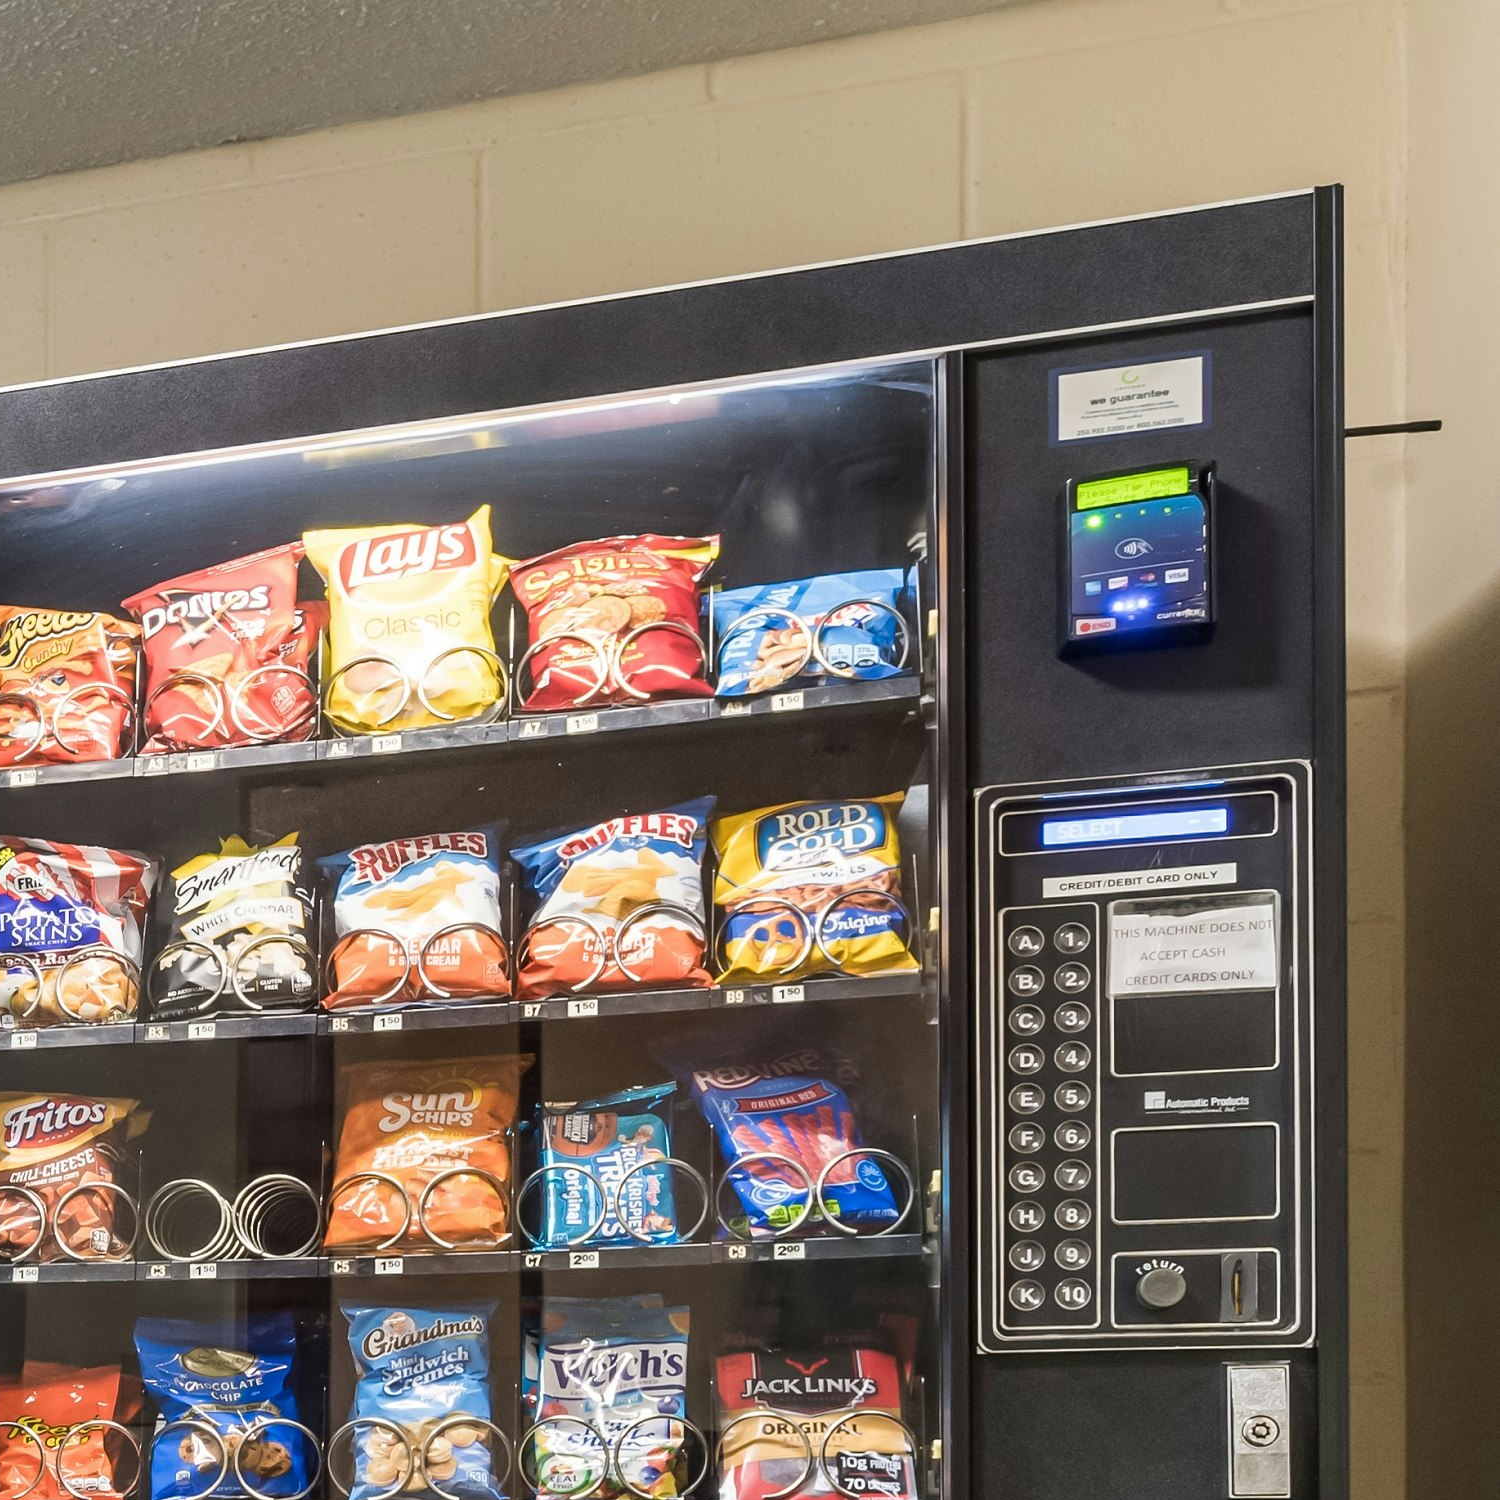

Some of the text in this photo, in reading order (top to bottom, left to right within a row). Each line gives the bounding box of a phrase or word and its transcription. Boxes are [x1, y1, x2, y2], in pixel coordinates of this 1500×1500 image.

[1090, 389, 1170, 405] we guarantee
[348, 522, 469, 588] Lay's
[364, 610, 462, 640] Classic
[23, 638, 72, 670] Crunchy
[776, 804, 869, 838] ROLD
[1058, 820, 1123, 840] SELECT
[352, 833, 486, 883] RUFFLES
[174, 849, 300, 911] Smartfood
[1059, 870, 1218, 891] CREDIT/DEBIT CARD ONLY
[0, 905, 94, 932] POTATO
[11, 925, 83, 947] SKINS
[1114, 919, 1272, 939] THIS MACHINE DOES NOT
[1018, 933, 1074, 950] A 1
[426, 956, 460, 966] CREAM
[1140, 947, 1226, 961] ACCEPT CASH
[260, 978, 282, 986] GLUTEN
[1018, 972, 1078, 989] B 2
[1125, 970, 1255, 986] CREDIT CARDS ONLY
[524, 1004, 541, 1017] B7
[1018, 1011, 1078, 1027] C 3
[1019, 1050, 1078, 1068] D 4
[751, 1088, 816, 1110] ORIGINAL RED
[1020, 1089, 1078, 1106] E 5
[1166, 1096, 1249, 1108] Automatic Products
[378, 1091, 477, 1132] Sun
[411, 1112, 473, 1126] CHIPS
[4, 1099, 106, 1148] Fritos
[1021, 1129, 1078, 1145] F 6
[9, 1148, 96, 1184] CHILI-CHEESE
[1018, 1168, 1078, 1185] G 7
[564, 1170, 582, 1225] original
[597, 1152, 628, 1237] TREATS
[1019, 1208, 1078, 1224] H 8
[525, 1255, 541, 1267] C7
[1021, 1248, 1078, 1264] J 9
[334, 1261, 349, 1273] C5
[1135, 1259, 1184, 1276] return
[1020, 1286, 1084, 1303] K 10
[362, 1315, 483, 1360] Grandma's
[742, 1377, 876, 1398] JACK LINK'S
[211, 1391, 241, 1402] CHIP
